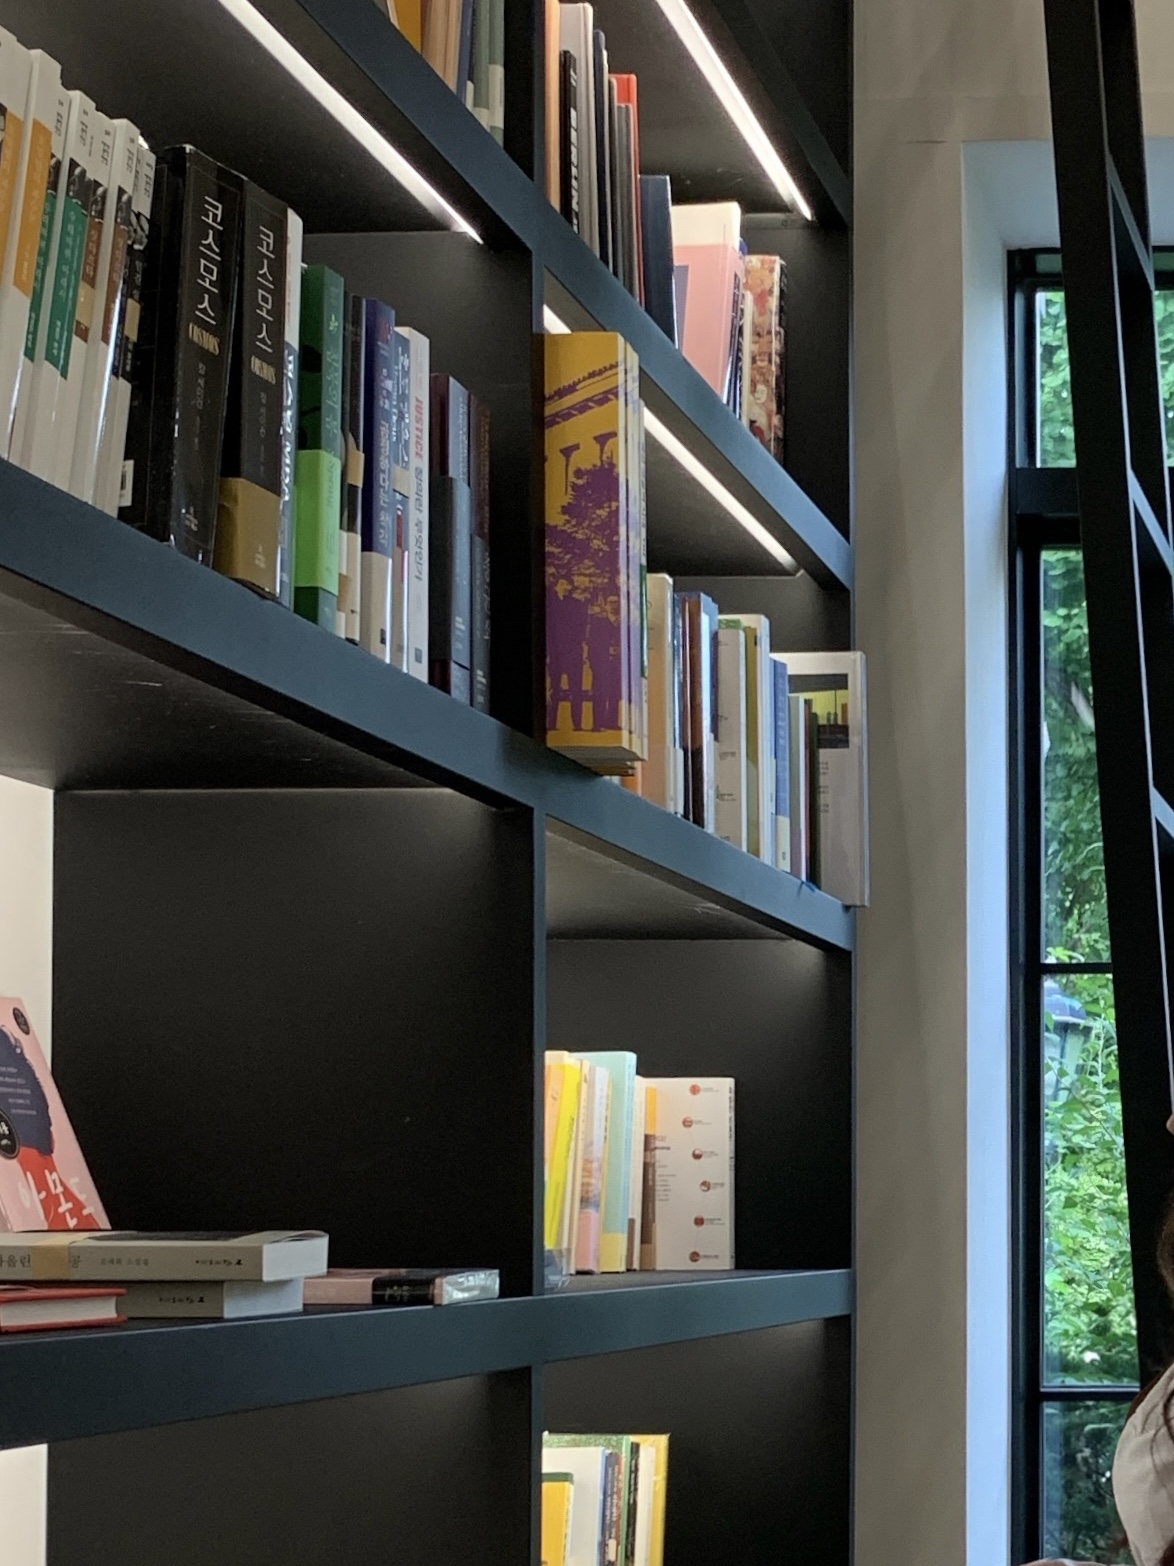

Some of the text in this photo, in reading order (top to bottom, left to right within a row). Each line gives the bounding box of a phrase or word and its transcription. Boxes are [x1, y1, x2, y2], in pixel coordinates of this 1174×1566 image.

[195, 195, 224, 325] 코스모스
[256, 225, 276, 353] 코스모스
[414, 396, 424, 460] JUSTICE
[413, 466, 424, 582] 정의란 무엇인가
[17, 1168, 96, 1230] 아몬드
